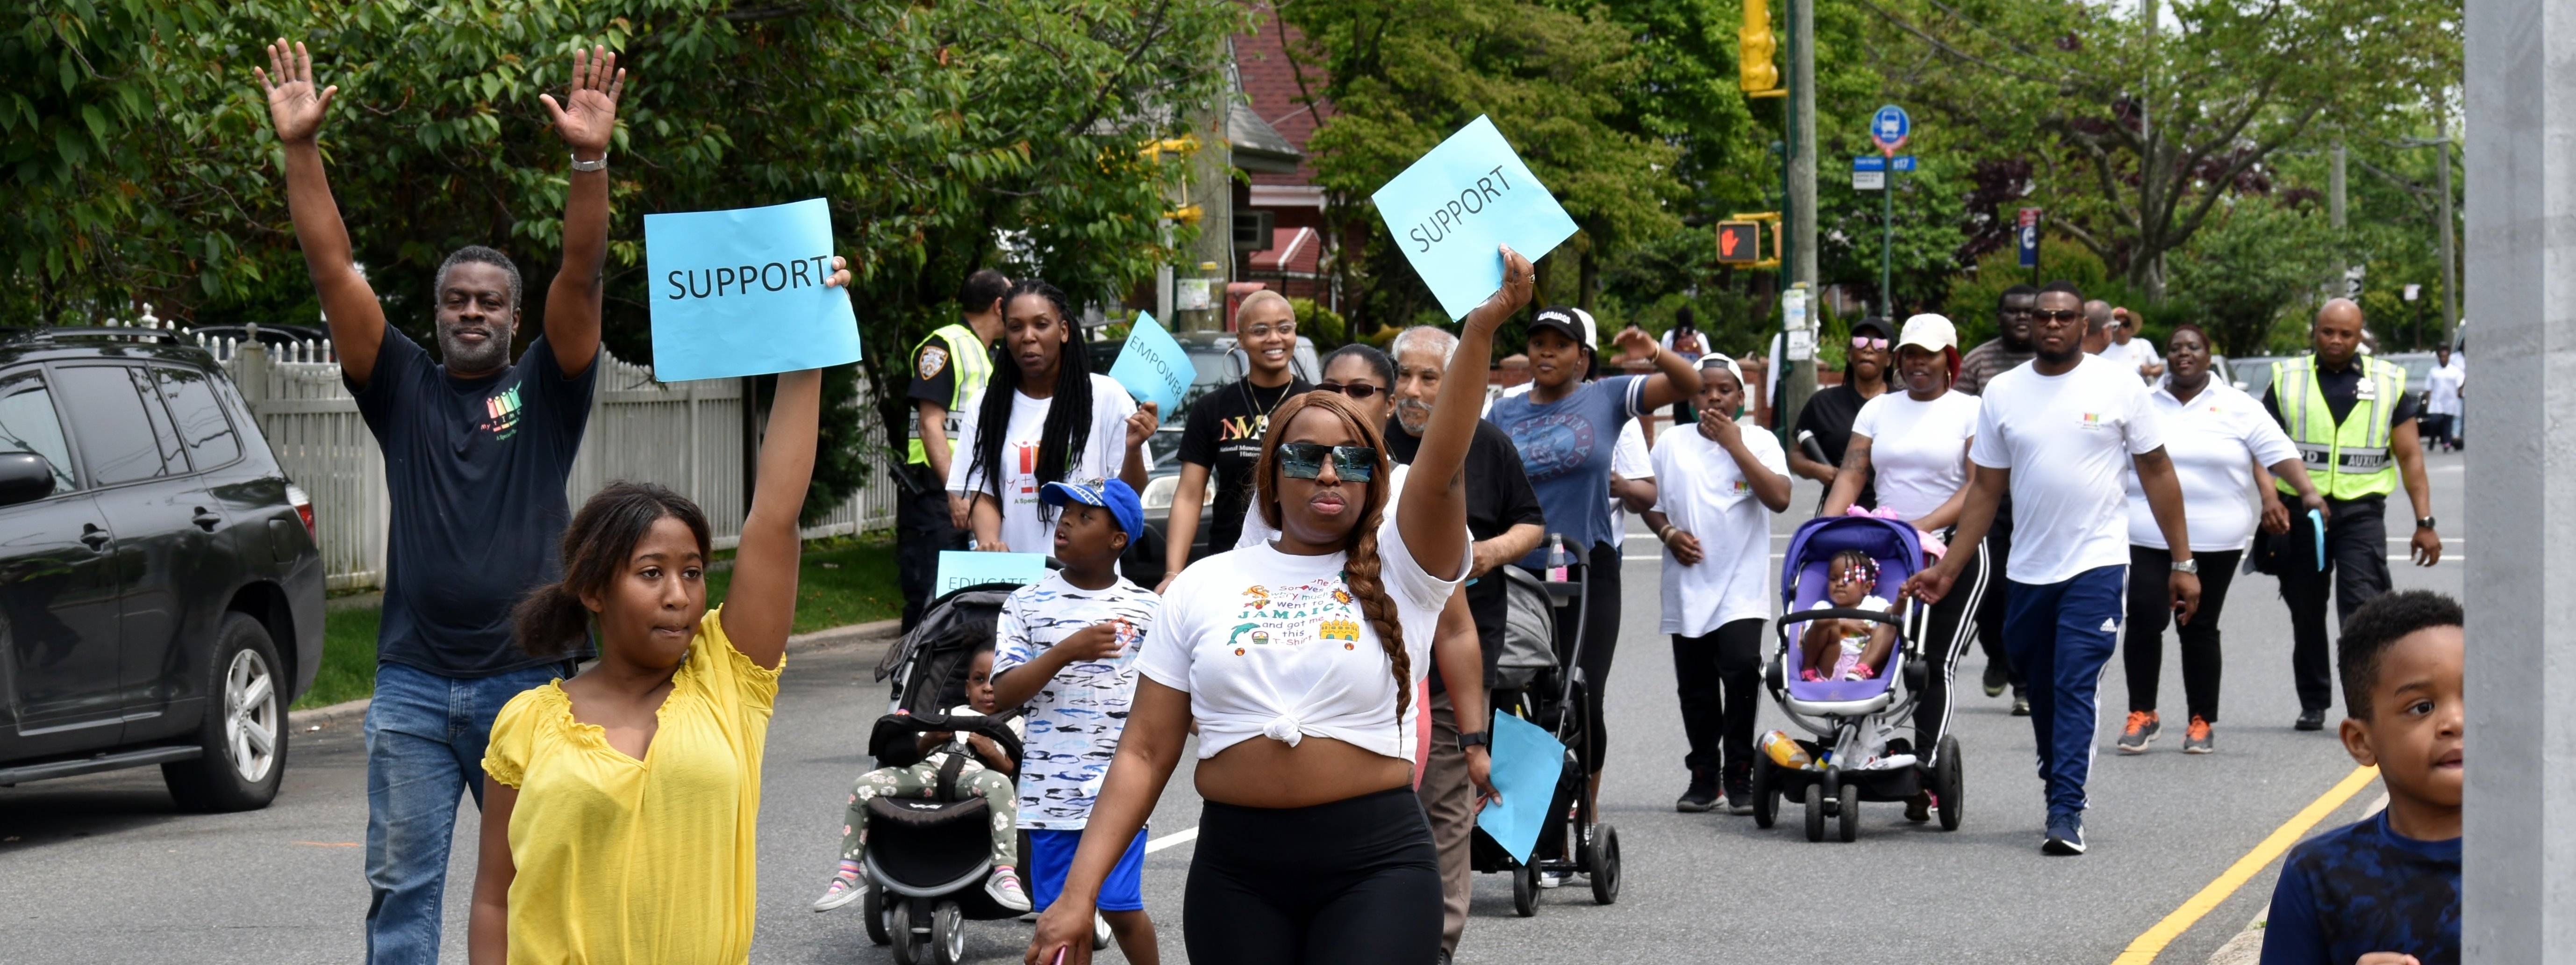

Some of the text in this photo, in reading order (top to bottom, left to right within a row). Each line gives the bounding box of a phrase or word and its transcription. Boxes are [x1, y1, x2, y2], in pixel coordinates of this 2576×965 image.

[1410, 165, 1510, 253] SUPPORT
[668, 255, 827, 300] SUPPORT
[1130, 335, 1181, 401] EMPOWER
[1510, 415, 1588, 436] APTAIN
[1302, 591, 1328, 600] much
[1238, 603, 1352, 619] JAMAICA
[1287, 620, 1305, 630] got
